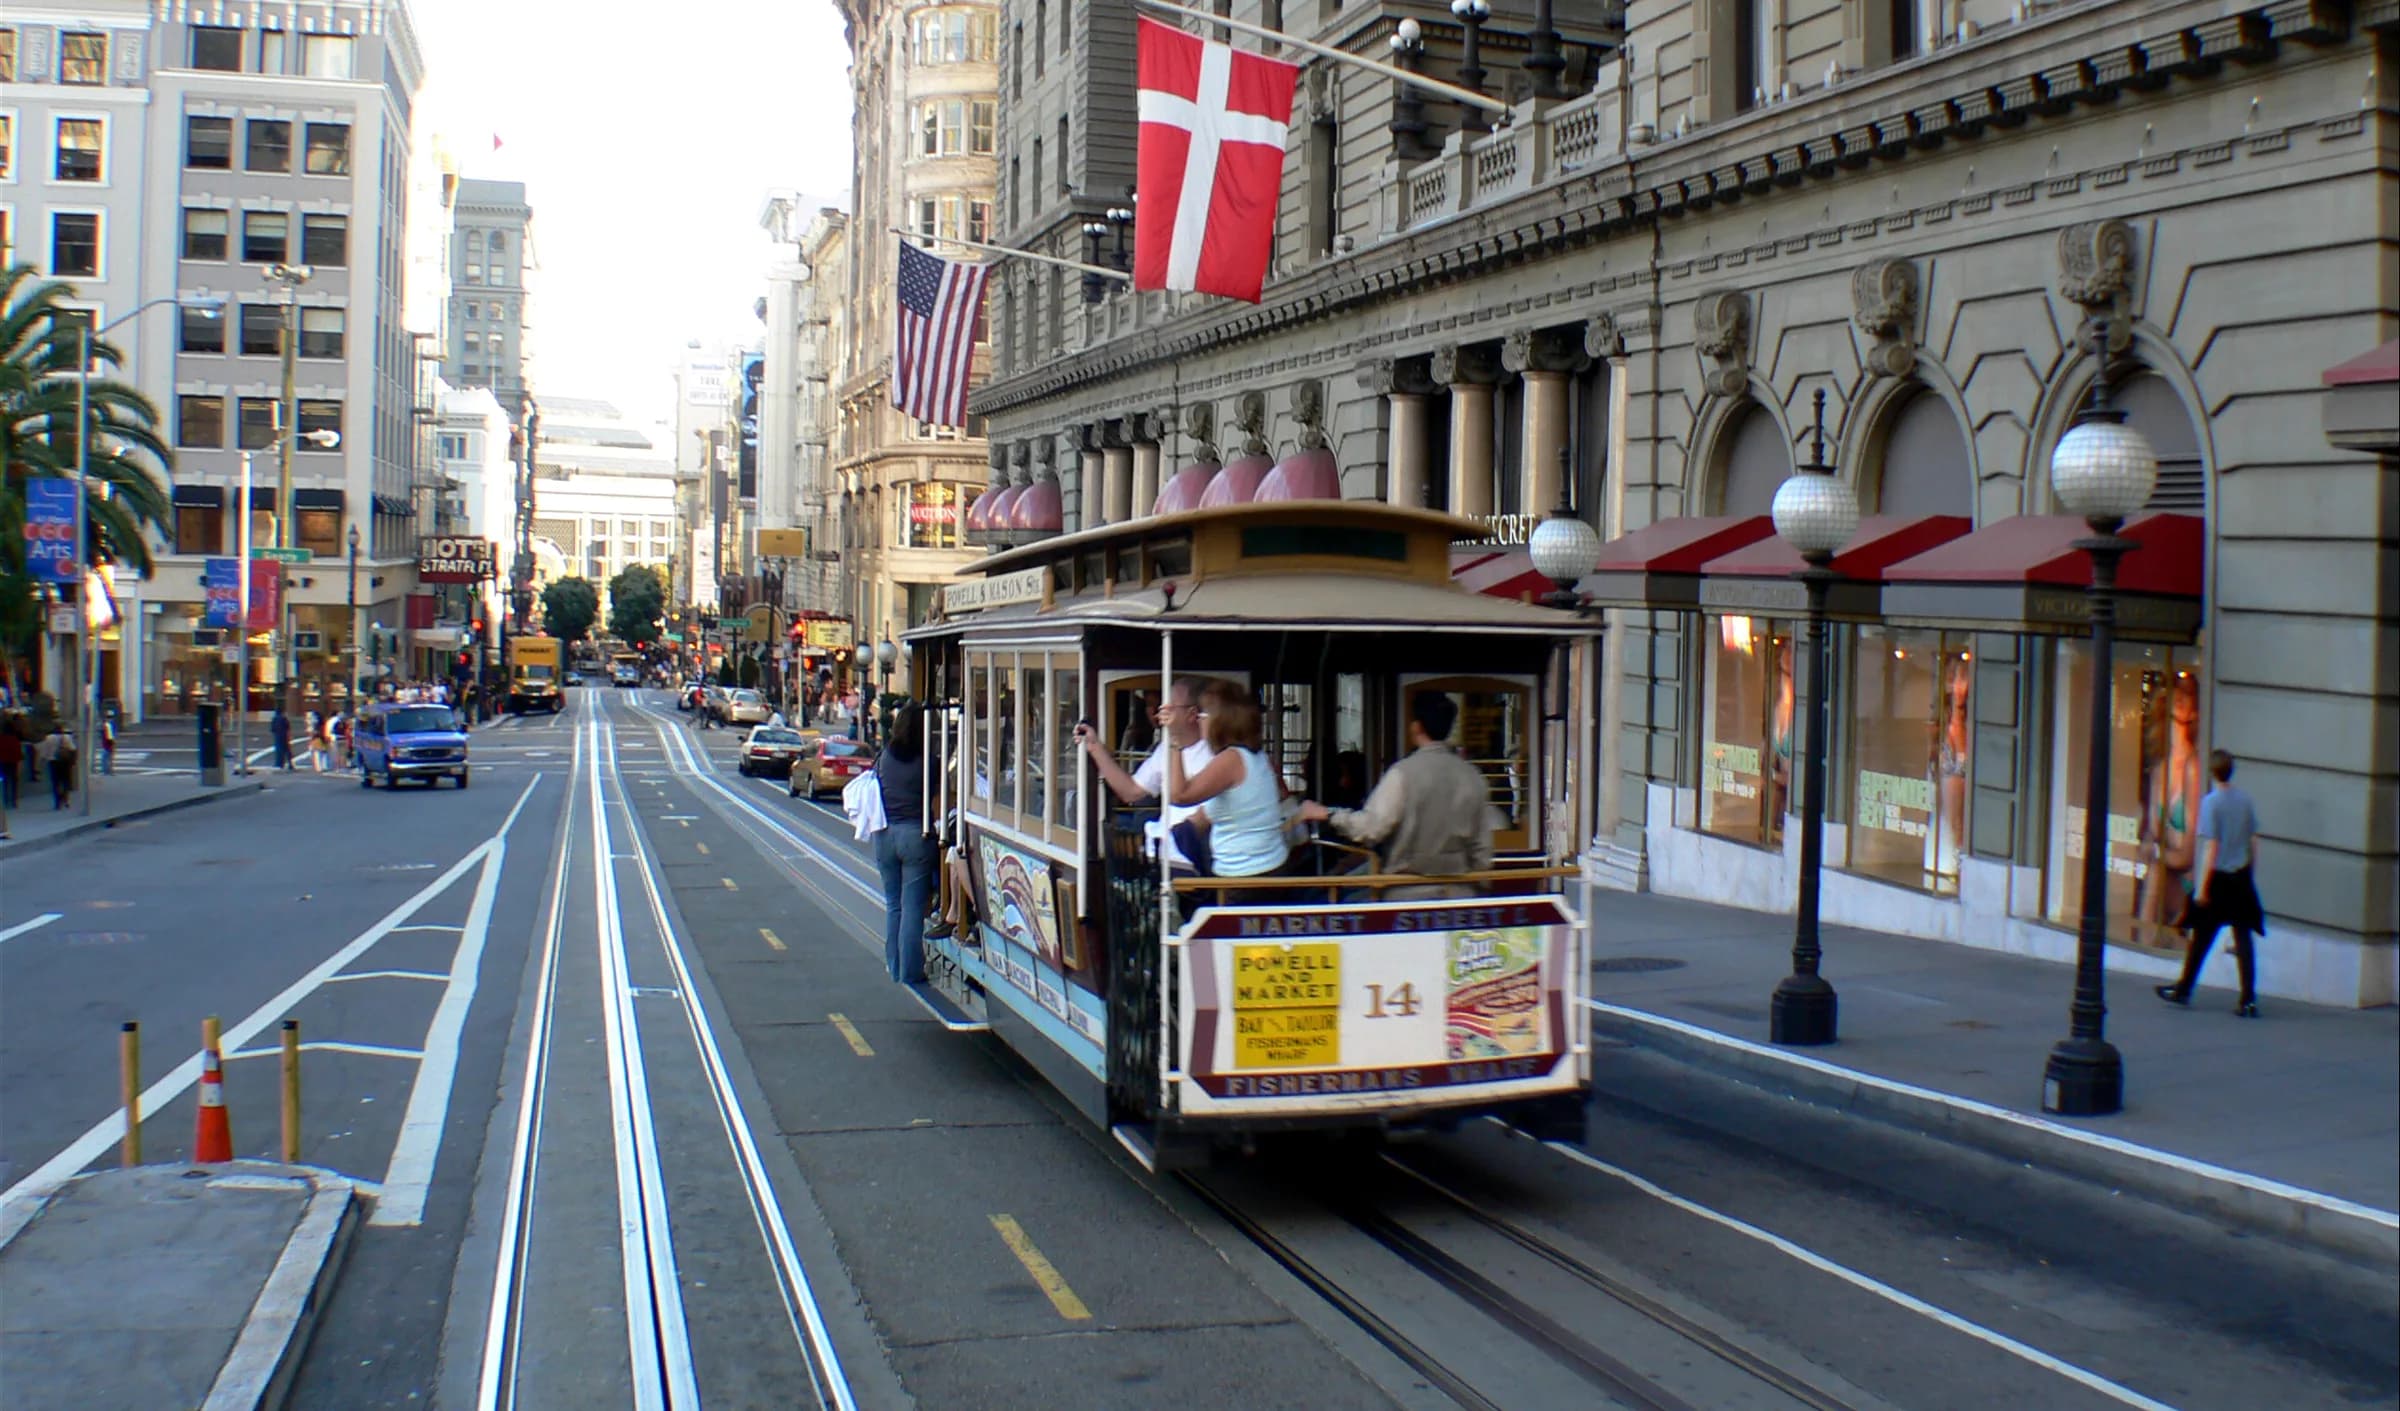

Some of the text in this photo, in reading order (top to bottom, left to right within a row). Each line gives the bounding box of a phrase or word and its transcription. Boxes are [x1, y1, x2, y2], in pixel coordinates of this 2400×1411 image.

[30, 539, 73, 559] Arts
[1240, 914, 1365, 936] MARKET
[1395, 907, 1504, 932] STREET
[1239, 955, 1335, 973] POWELL
[1264, 970, 1313, 984] AND
[1238, 983, 1337, 1002] MARKET
[1363, 981, 1421, 1019] 14
[1237, 1016, 1264, 1034] BAY
[1226, 1058, 1538, 1097] FISHERMANS WHARF
